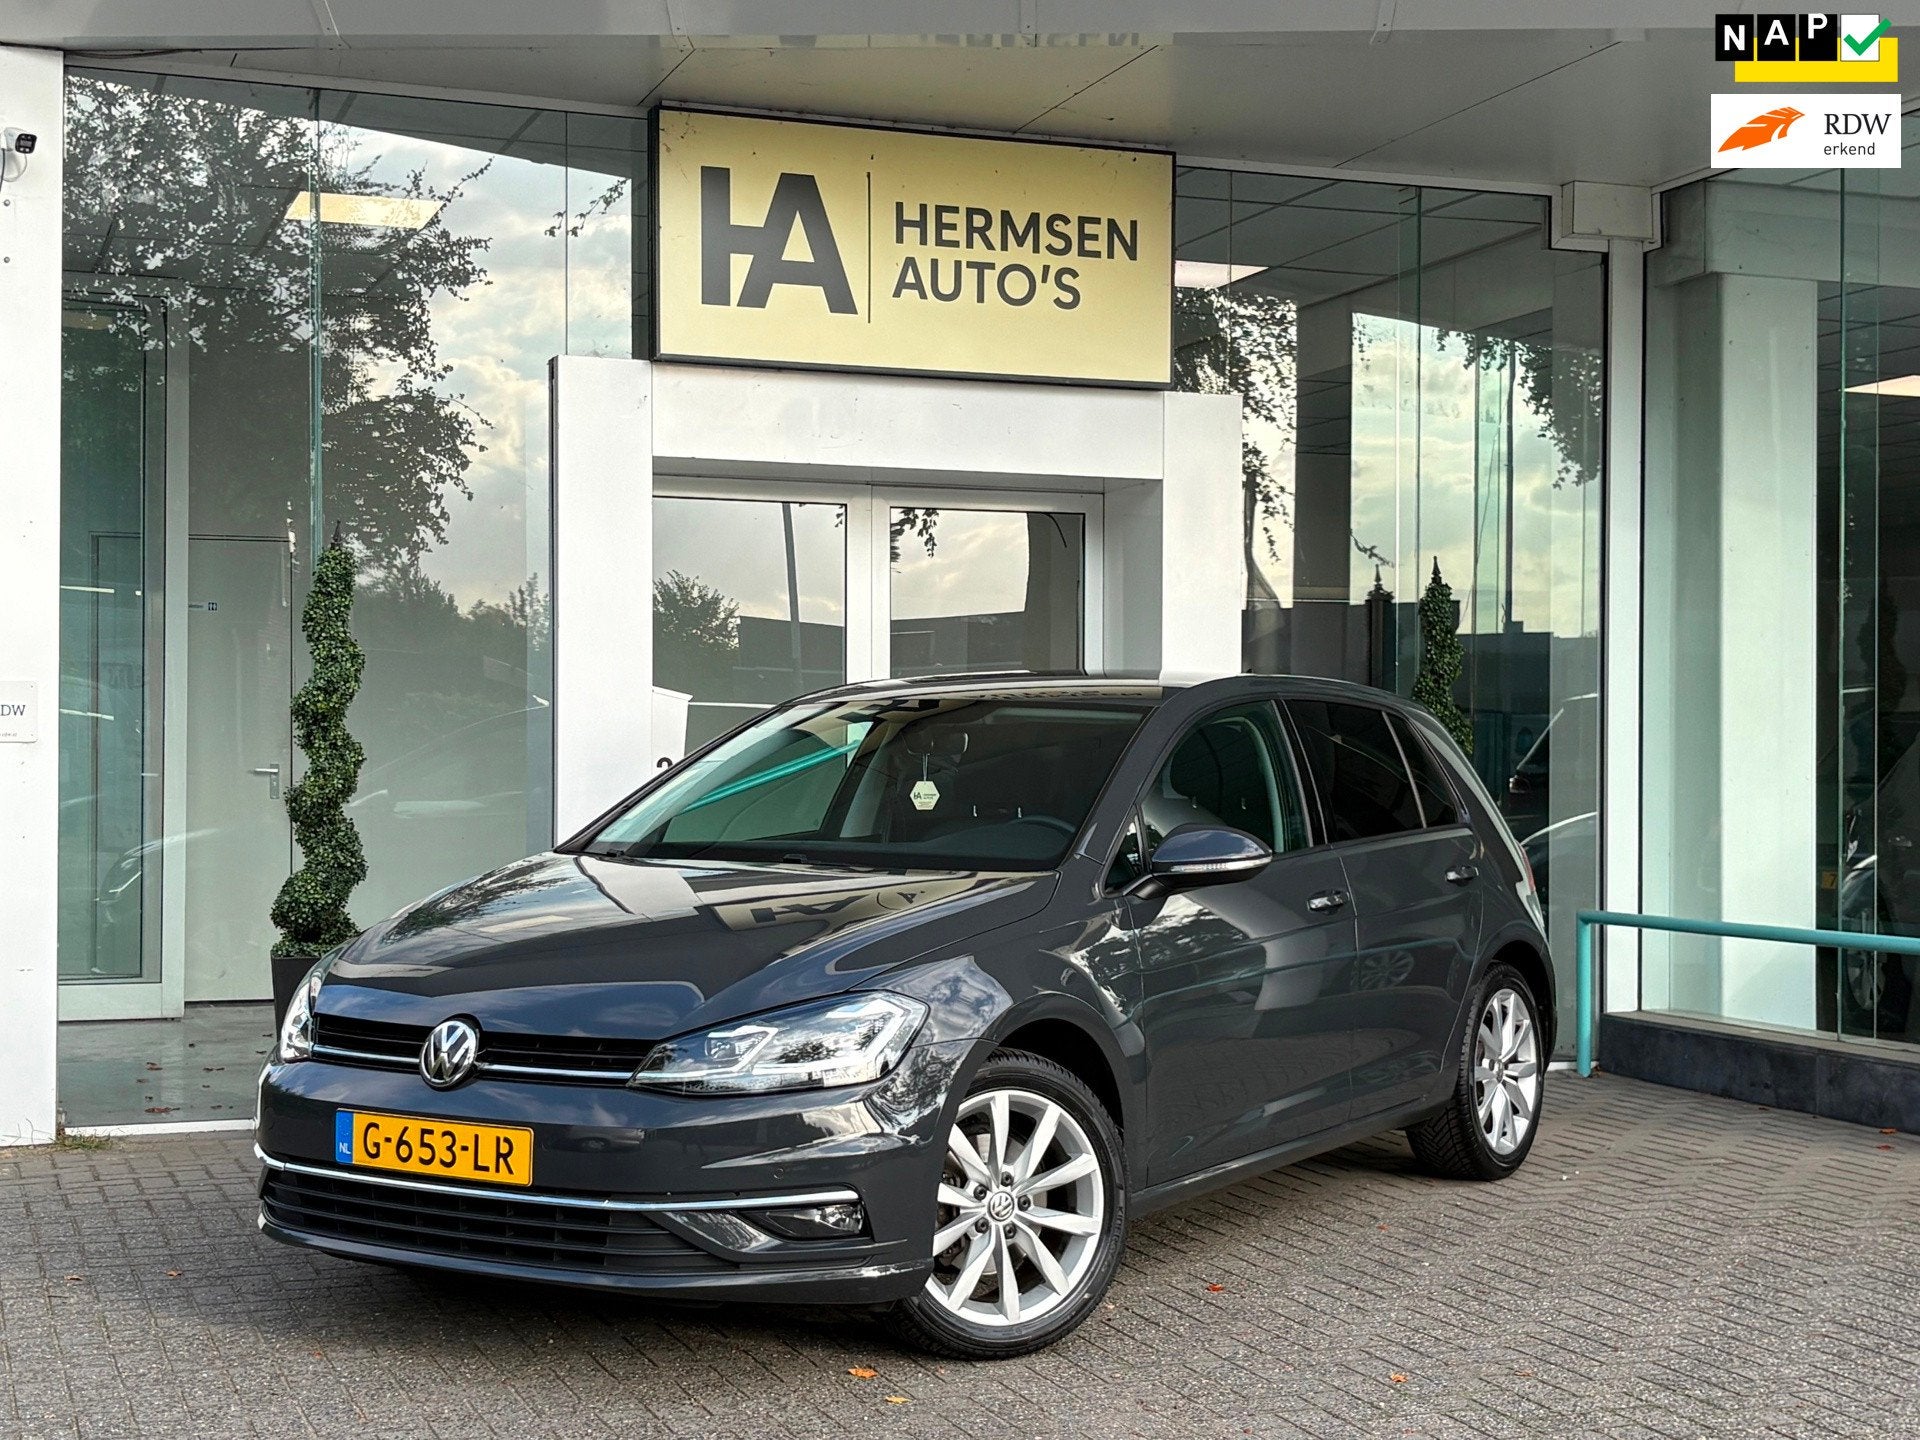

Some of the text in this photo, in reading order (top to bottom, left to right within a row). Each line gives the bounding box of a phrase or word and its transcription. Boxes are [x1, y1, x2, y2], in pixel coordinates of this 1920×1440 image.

[701, 166, 858, 314] HA
[895, 201, 1138, 261] HERMSEN
[892, 256, 1081, 310] AUTO'S
[0, 704, 26, 716] DW
[421, 1021, 476, 1085] VW
[339, 1142, 352, 1154] NL
[363, 1121, 514, 1175] G-653-LR
